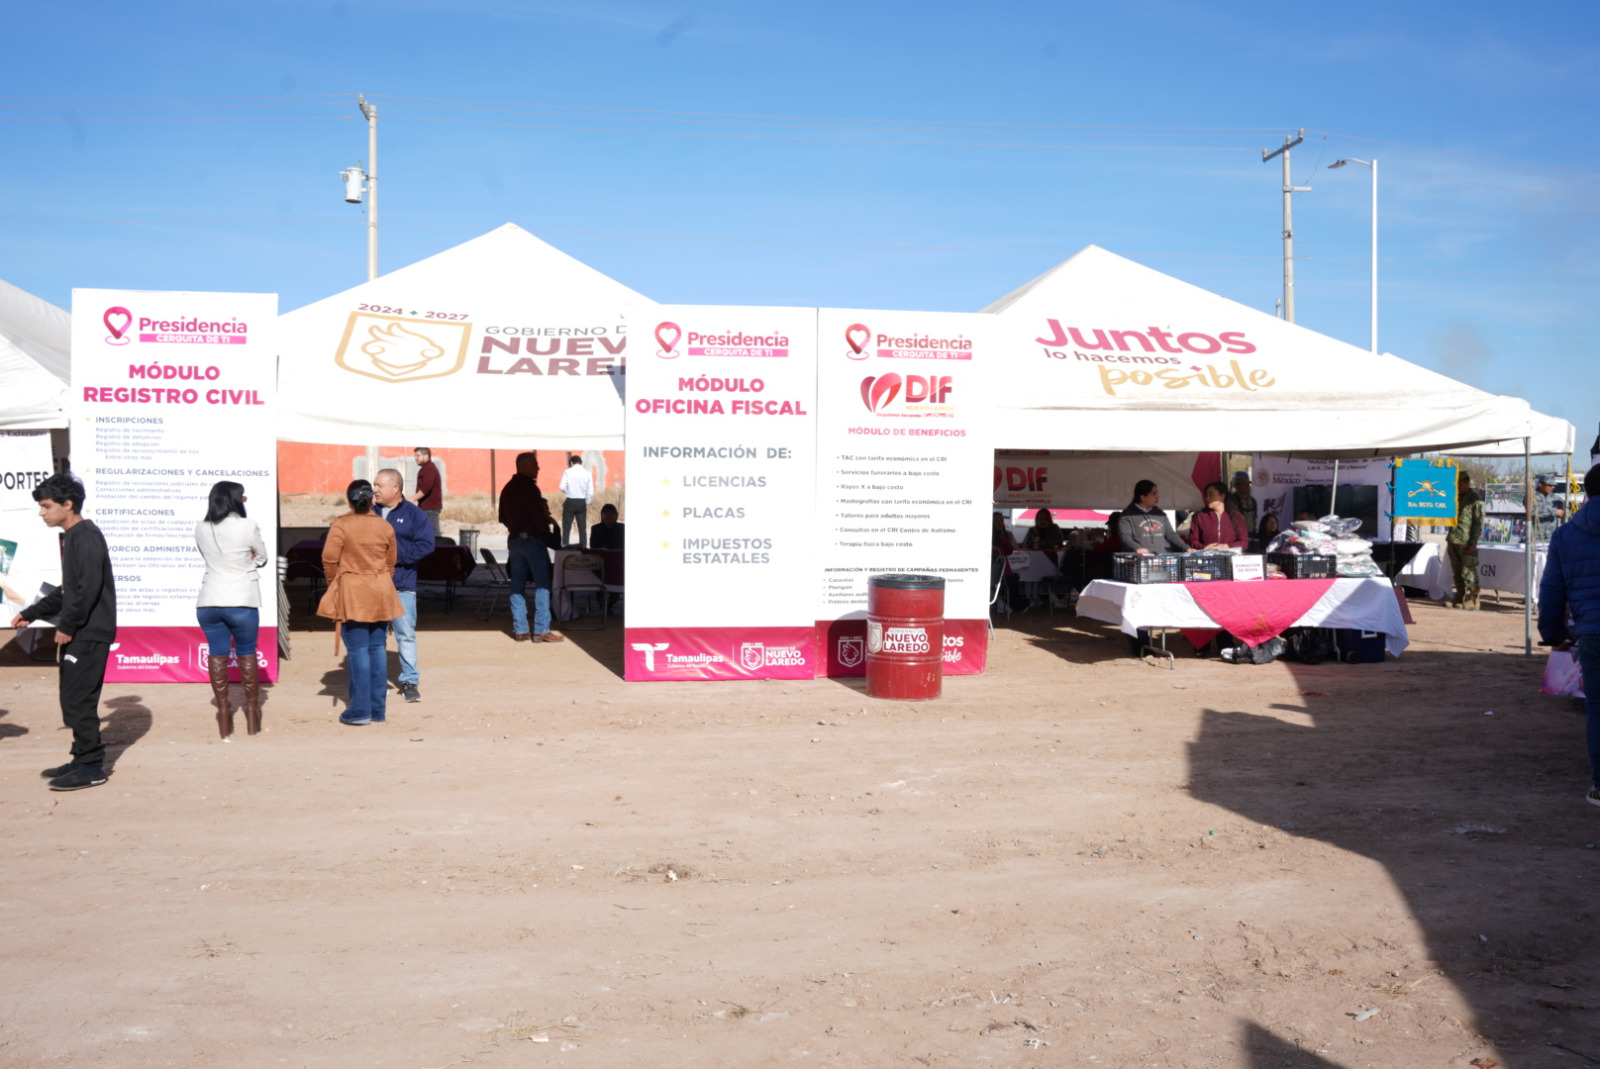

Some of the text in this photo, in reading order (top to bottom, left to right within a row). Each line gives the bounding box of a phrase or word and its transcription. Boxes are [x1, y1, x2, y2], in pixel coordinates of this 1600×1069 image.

[358, 304, 469, 321] 2024 2027
[139, 315, 248, 334] Presidencia
[486, 326, 626, 336] GOBIERNO D
[156, 334, 204, 343] CERQUITA
[688, 330, 789, 347] Presidencia
[877, 333, 972, 350] Presidencia
[1035, 318, 1256, 354] Juntos
[481, 335, 626, 356] NUEV
[704, 348, 748, 356] CERQUITA
[1044, 348, 1182, 365] lo hacemos
[129, 361, 220, 380] MÓDULO
[476, 356, 626, 376] LARE
[678, 374, 764, 392] MÓDULO
[1098, 360, 1276, 396] posible
[83, 387, 265, 405] REGISTRO CIVIL
[906, 374, 952, 404] DIF
[636, 398, 807, 415] OFICINA FISCAL
[848, 426, 890, 435] MÓDULO
[909, 429, 966, 437] BENEFICIOS
[643, 445, 792, 459] INFORMACIÓN DE:
[683, 476, 767, 487] LICENCIAS
[1006, 467, 1048, 492] DIF
[683, 507, 745, 518] PLACAS
[683, 538, 772, 550] IMPUESTOS
[683, 552, 770, 564] ESTATALES
[1480, 565, 1496, 577] GN
[886, 634, 927, 642] NUEVO
[884, 643, 929, 652] LAREDO
[115, 654, 179, 666] Tamaulipas
[666, 653, 724, 665] Tamaulipas
